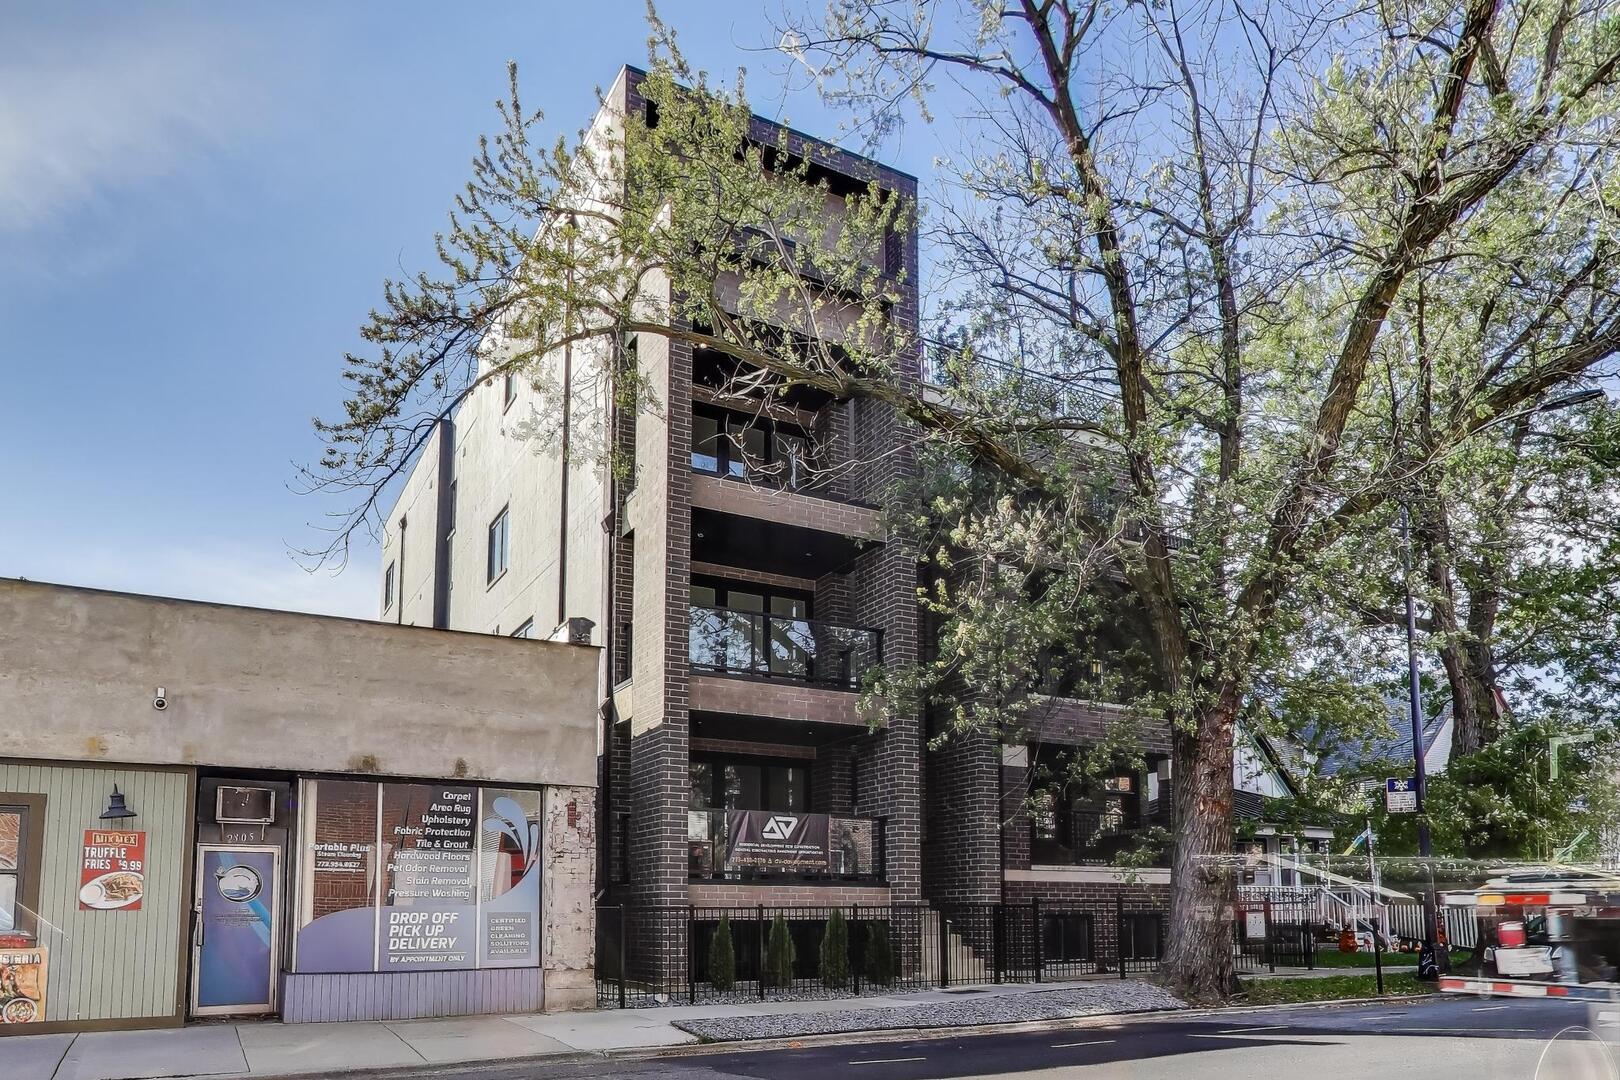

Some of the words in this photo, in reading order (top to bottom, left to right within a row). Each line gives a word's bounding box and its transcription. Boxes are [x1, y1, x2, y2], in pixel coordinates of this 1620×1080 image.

[443, 791, 471, 802] Carpet
[430, 803, 452, 812] Area
[454, 804, 471, 814] Rug
[421, 814, 471, 826] Upholstery
[394, 826, 422, 835] Fabric
[425, 827, 471, 837] Protection
[309, 842, 348, 851] Portable
[416, 839, 432, 848] Tile
[434, 840, 441, 848] &
[443, 839, 468, 849] Grout
[84, 846, 127, 858] TRUFFLE
[394, 851, 441, 860] Hardwood
[442, 852, 470, 861] Floors
[84, 858, 111, 870] FRIES
[118, 860, 142, 870] $9.99
[386, 863, 403, 872] Pet
[405, 863, 428, 872] Odor
[429, 864, 468, 873] Removal
[406, 876, 429, 884] Stain
[430, 877, 470, 885] Removal
[388, 888, 430, 897] Pressure
[431, 889, 470, 899] Washing
[389, 912, 429, 924] DROP
[431, 912, 459, 924] OFF
[389, 925, 422, 937] PICK
[425, 925, 445, 937] UP
[388, 937, 458, 950] DELIVERY
[400, 955, 447, 963] APPOINTMENT
